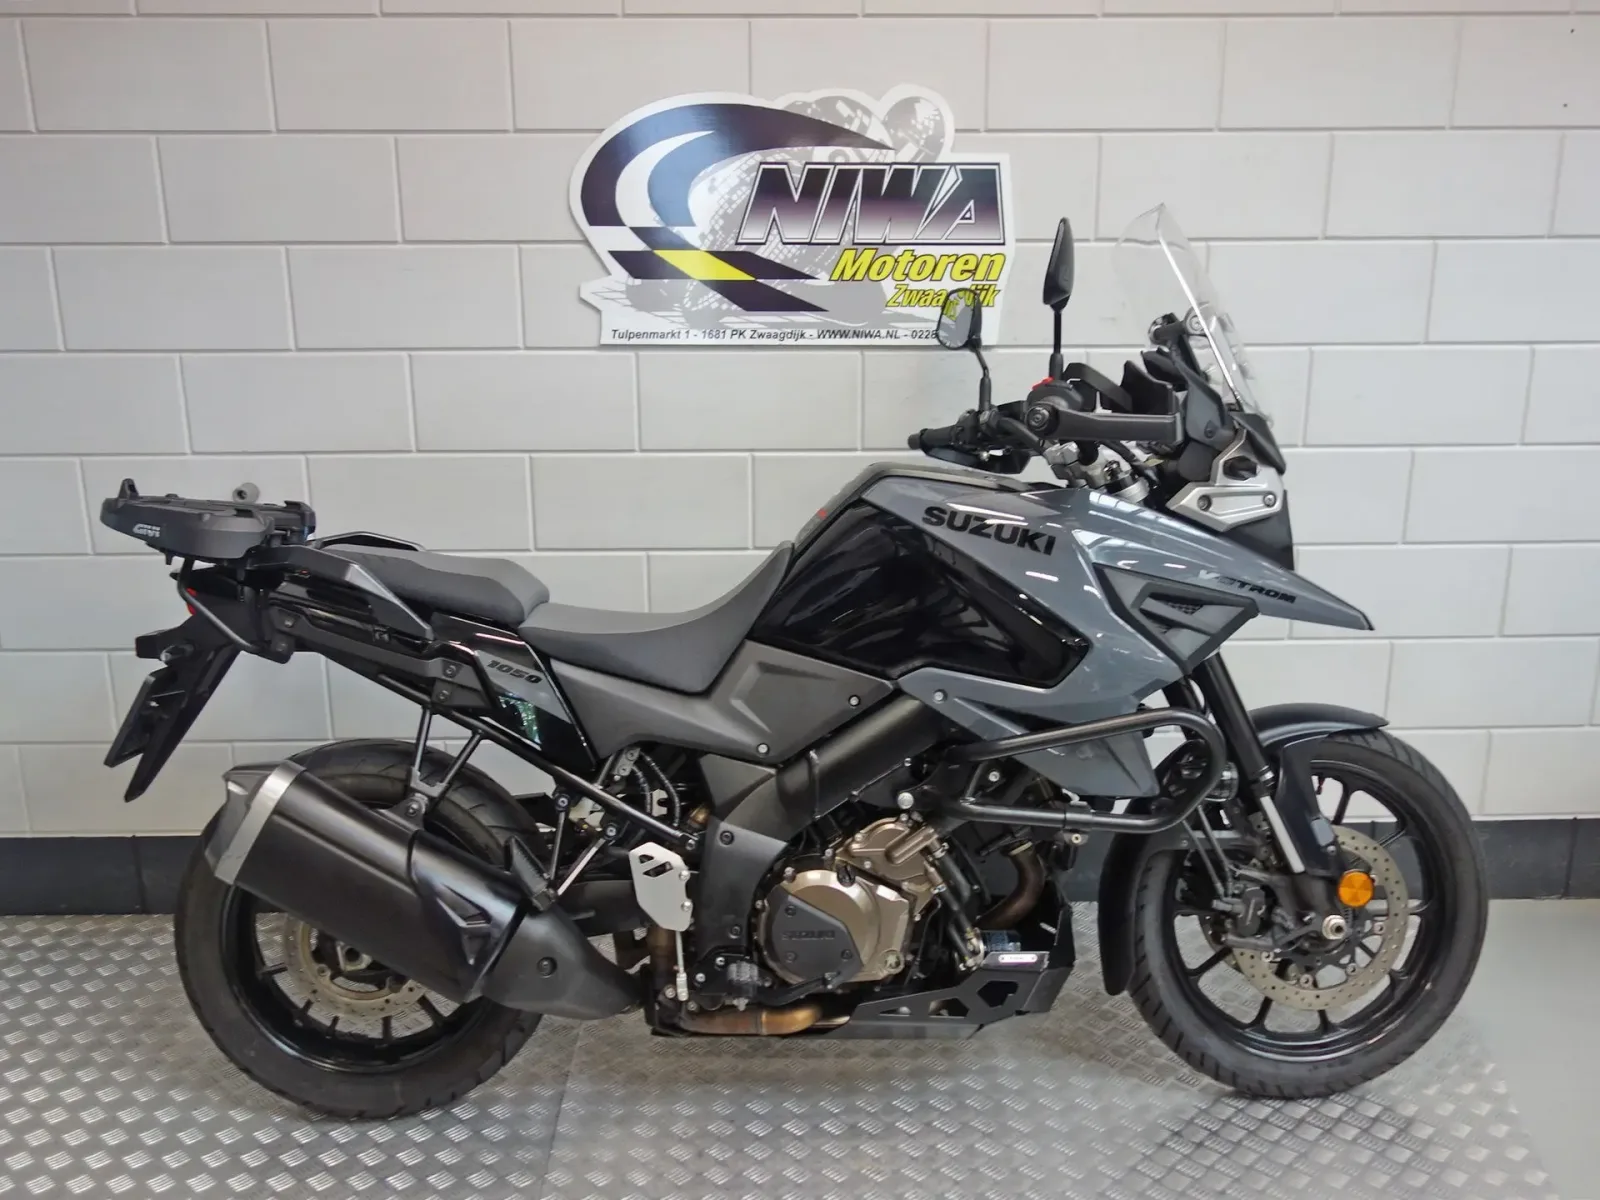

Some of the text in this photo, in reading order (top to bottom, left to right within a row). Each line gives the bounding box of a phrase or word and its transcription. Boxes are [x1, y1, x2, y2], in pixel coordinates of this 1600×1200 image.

[736, 162, 1006, 245] NIWA
[829, 247, 1006, 282] Motoren
[611, 329, 681, 341] Tulpenmarkt
[684, 329, 690, 339] 1
[701, 329, 726, 339] 1681
[729, 329, 747, 339] PK
[749, 329, 806, 342] Zwaagdijk
[816, 329, 900, 339] WWW.NIWA.NL
[922, 506, 1057, 556] SUZUKI
[487, 659, 543, 684] 1050
